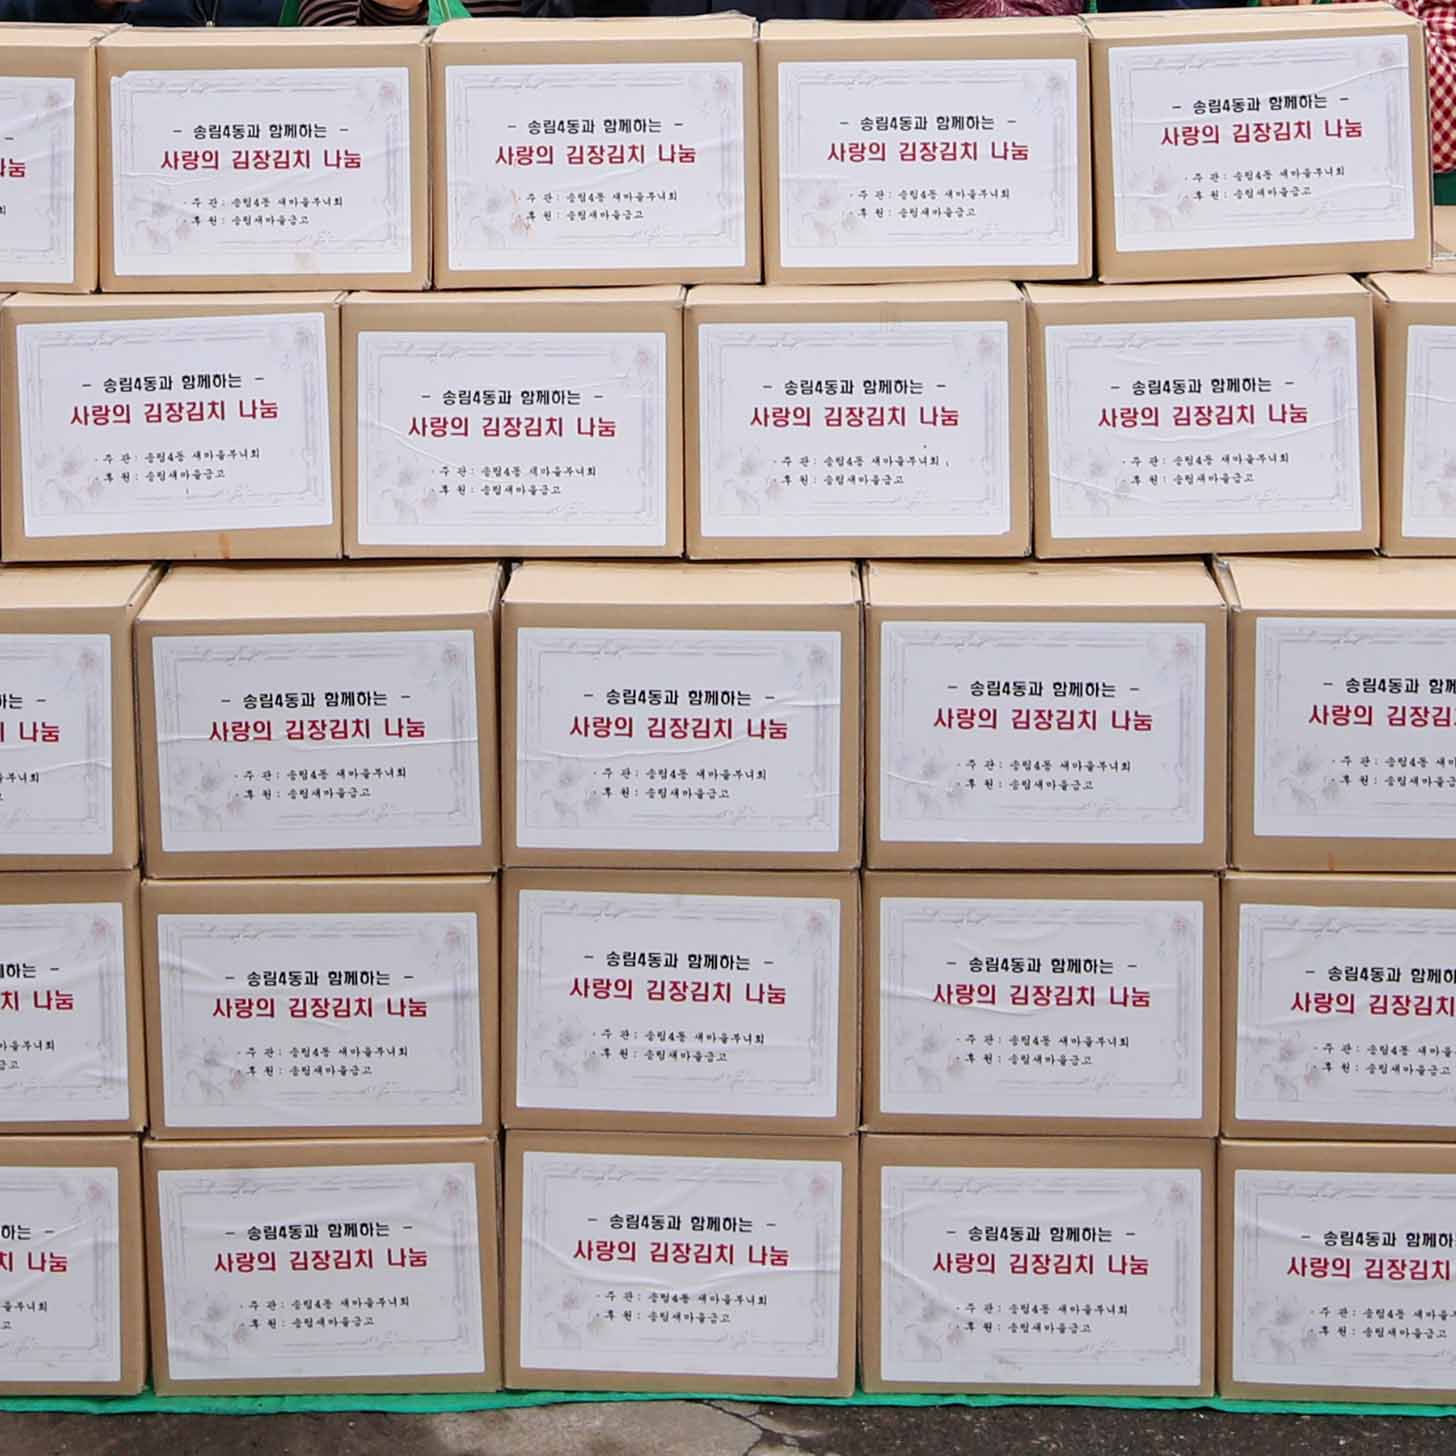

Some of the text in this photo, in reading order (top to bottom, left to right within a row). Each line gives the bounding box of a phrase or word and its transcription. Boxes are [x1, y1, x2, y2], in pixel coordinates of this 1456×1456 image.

[1193, 94, 1327, 115] 송림4동과 함께하는
[194, 124, 326, 140] 송림4동과 함께하는
[1161, 119, 1362, 146] 사랑의 김장김치 나눔
[161, 150, 361, 170] 사랑의 김장김치 나눔
[496, 144, 696, 166] 사랑의 김장김치 나눔
[828, 142, 1028, 162] 사랑의 김장김치 나눔
[104, 373, 241, 393] 송림4동과 함께하는
[785, 379, 923, 395] 송림4동과 함께하는
[71, 399, 278, 426] 사랑의 김장김치 나눔
[750, 406, 959, 427] 사랑의 김장김치 나눔
[1099, 404, 1307, 428] 사랑의 김장김치 나눔
[409, 416, 616, 437] 사랑의 김장김치 나눔
[607, 689, 751, 706] 송림4동과 함께하는
[934, 708, 1152, 731] 사랑의 김장김치 나눔
[1309, 705, 1372, 726] 사랑의
[20, 722, 59, 743] 나눔
[209, 718, 425, 742] 사랑의 김장김치 나눔
[571, 716, 787, 740] 사랑의 김장김치 나눔
[248, 971, 390, 987] 송림4동과 함께하는
[1328, 966, 1401, 982] 송림4동과
[34, 990, 73, 1010] 나눔
[570, 978, 786, 1005] 사랑의 김장김치 나눔
[934, 984, 1150, 1008] 사랑의 김장김치 나눔
[213, 997, 427, 1019] 사랑의 김장김치 나눔
[1291, 992, 1354, 1014] 사랑의
[1369, 995, 1455, 1017] 김장김치
[969, 1226, 1112, 1242] 송림4동과 함께하는
[28, 1252, 67, 1272] 나눔
[215, 1248, 427, 1273] 사랑의 김장김치 나눔
[573, 1240, 788, 1266] 사랑의 김장김치 나눔
[933, 1253, 1148, 1275] 사랑의 김장김치 나눔
[1287, 1257, 1350, 1279] 사랑의
[1365, 1259, 1450, 1280] 김장김치
